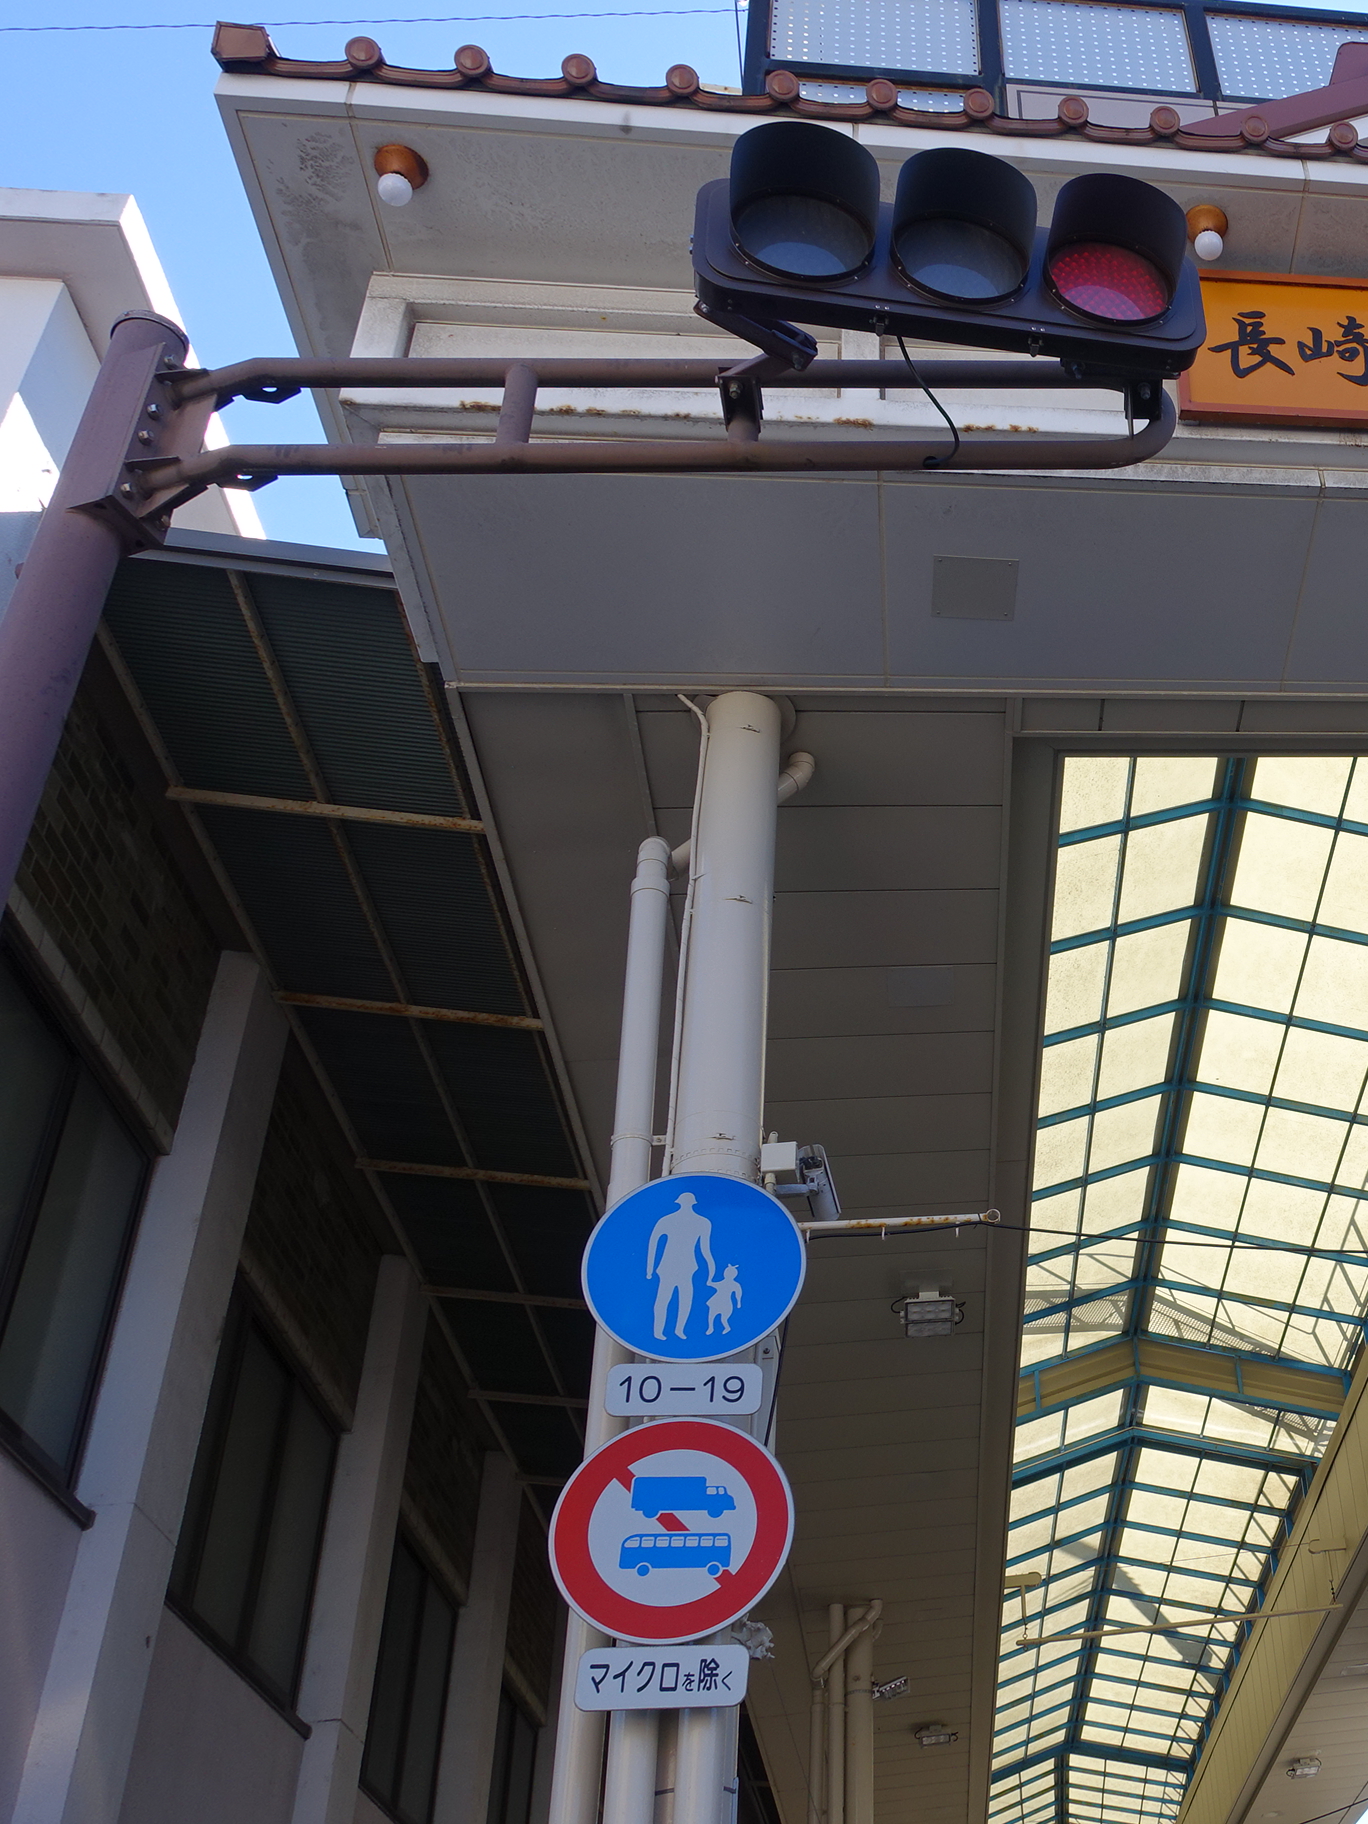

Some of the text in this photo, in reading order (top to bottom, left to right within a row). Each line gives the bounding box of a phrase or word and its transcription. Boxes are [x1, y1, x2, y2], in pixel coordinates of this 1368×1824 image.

[588, 1658, 733, 1695] マイクロを除く
